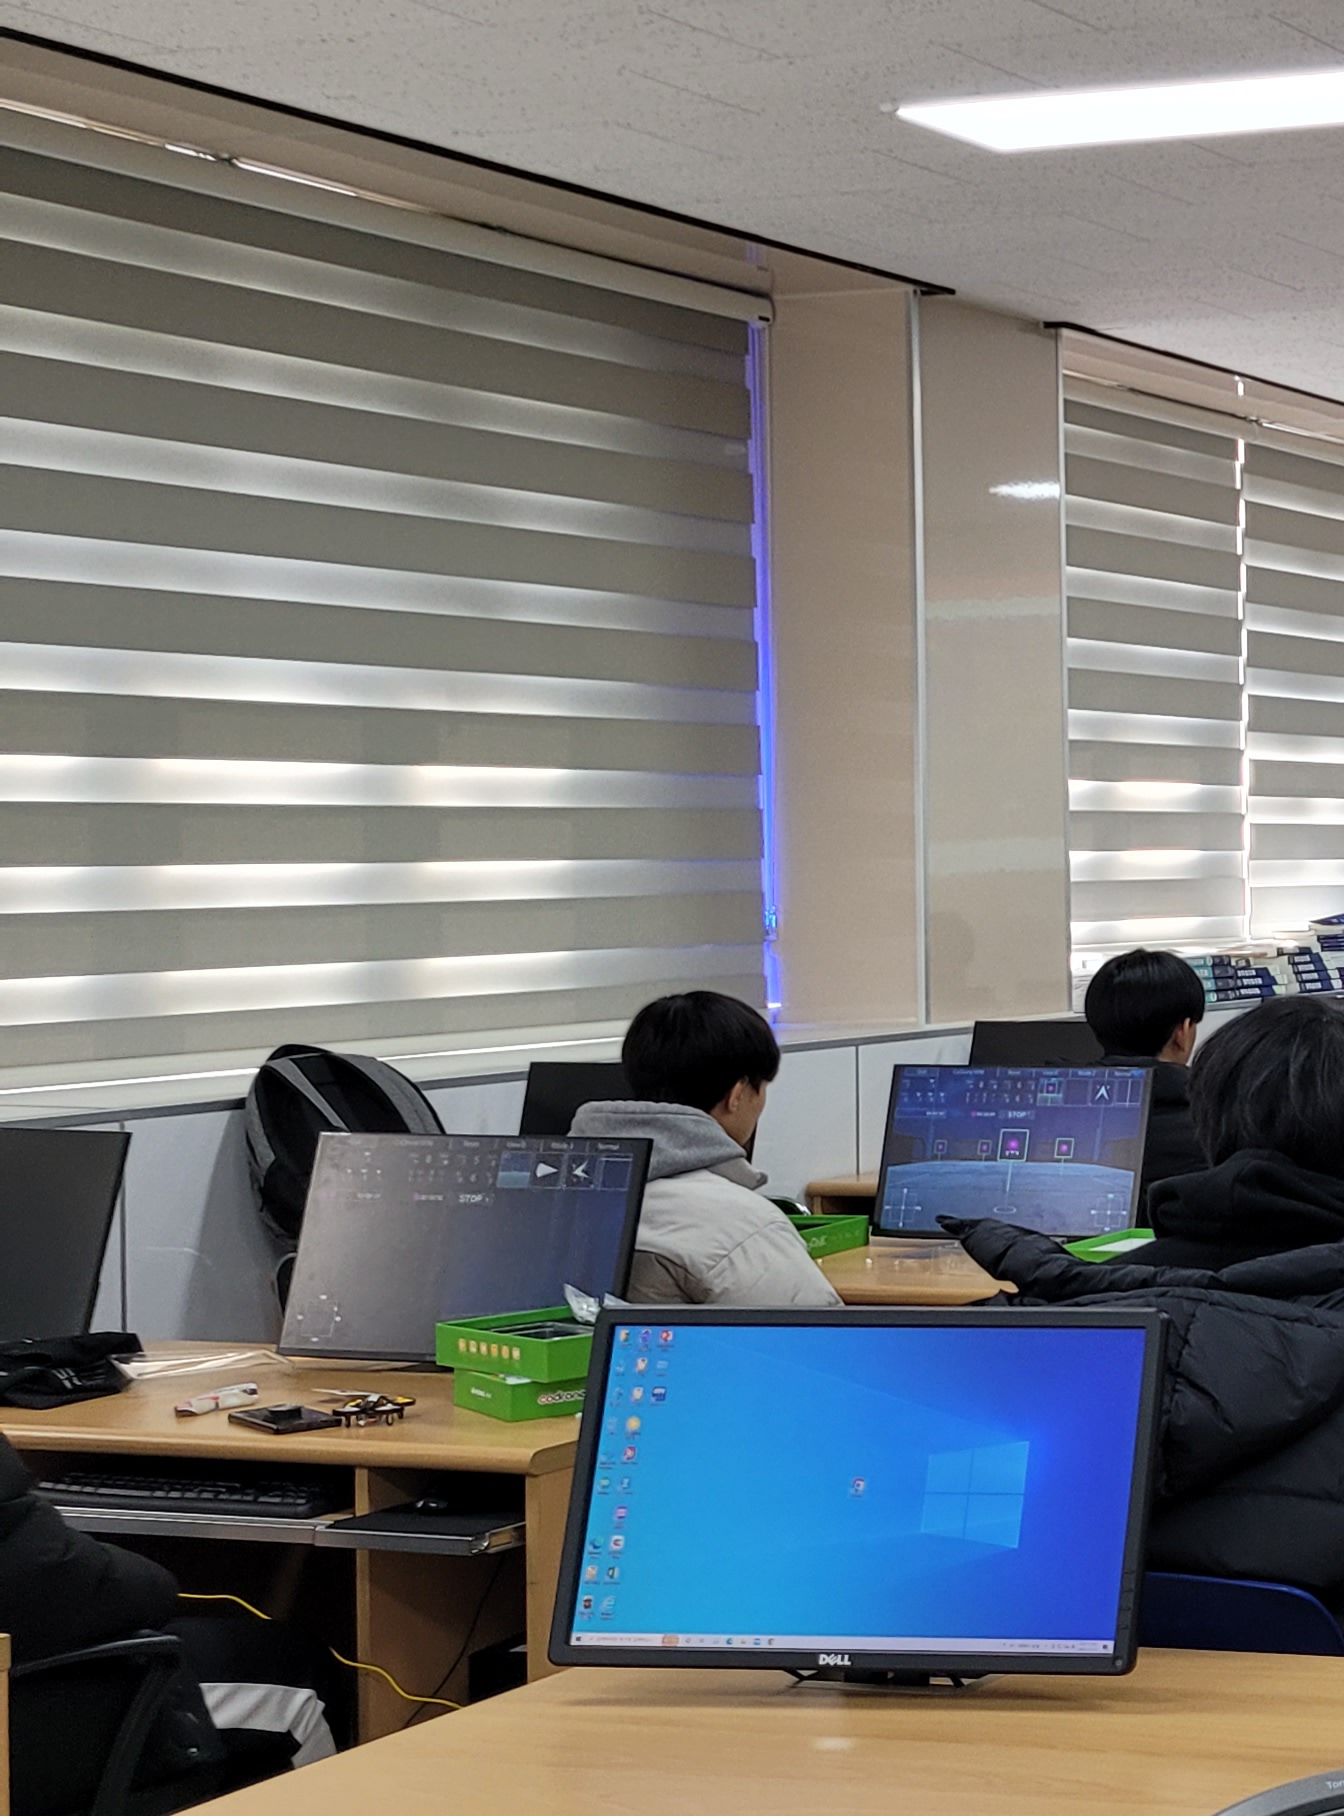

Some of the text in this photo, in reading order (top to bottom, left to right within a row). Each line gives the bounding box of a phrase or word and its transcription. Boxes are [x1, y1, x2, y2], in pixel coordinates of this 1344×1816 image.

[1008, 1111, 1027, 1119] STOP
[458, 1193, 483, 1204] STOP
[818, 1653, 851, 1666] DELL
